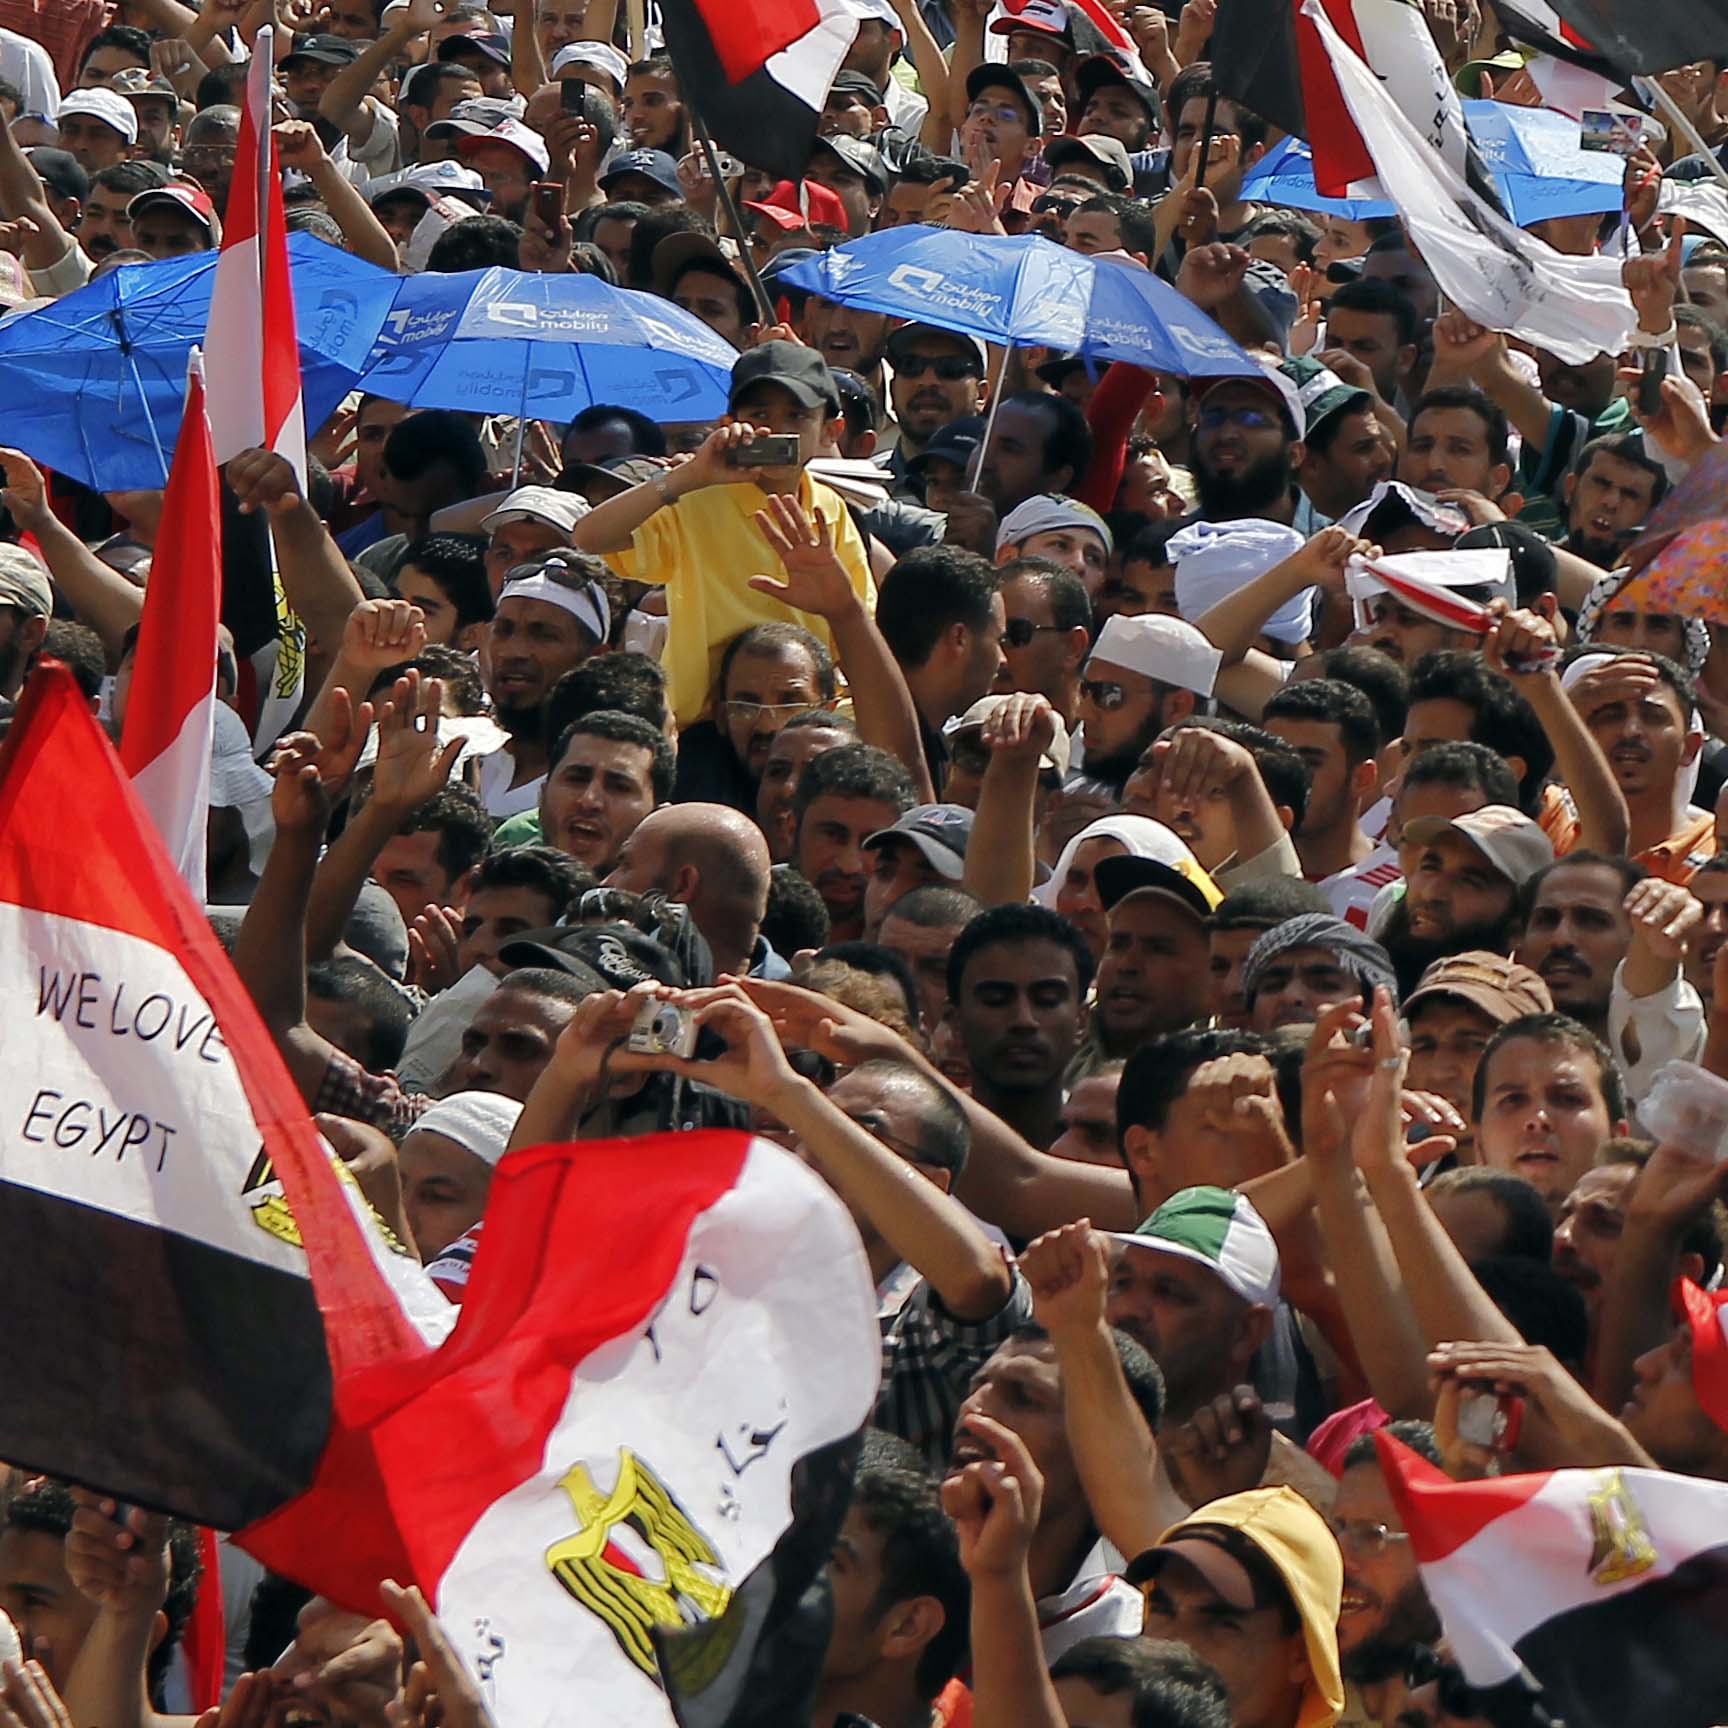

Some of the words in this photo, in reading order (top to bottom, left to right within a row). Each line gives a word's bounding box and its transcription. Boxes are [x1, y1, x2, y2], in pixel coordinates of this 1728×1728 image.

[930, 289, 994, 318] mobily
[401, 321, 449, 344] mobily
[538, 319, 610, 333] mobily
[35, 964, 101, 1029] WE
[110, 981, 228, 1063] LOVE
[21, 1088, 177, 1174] EGYPT
